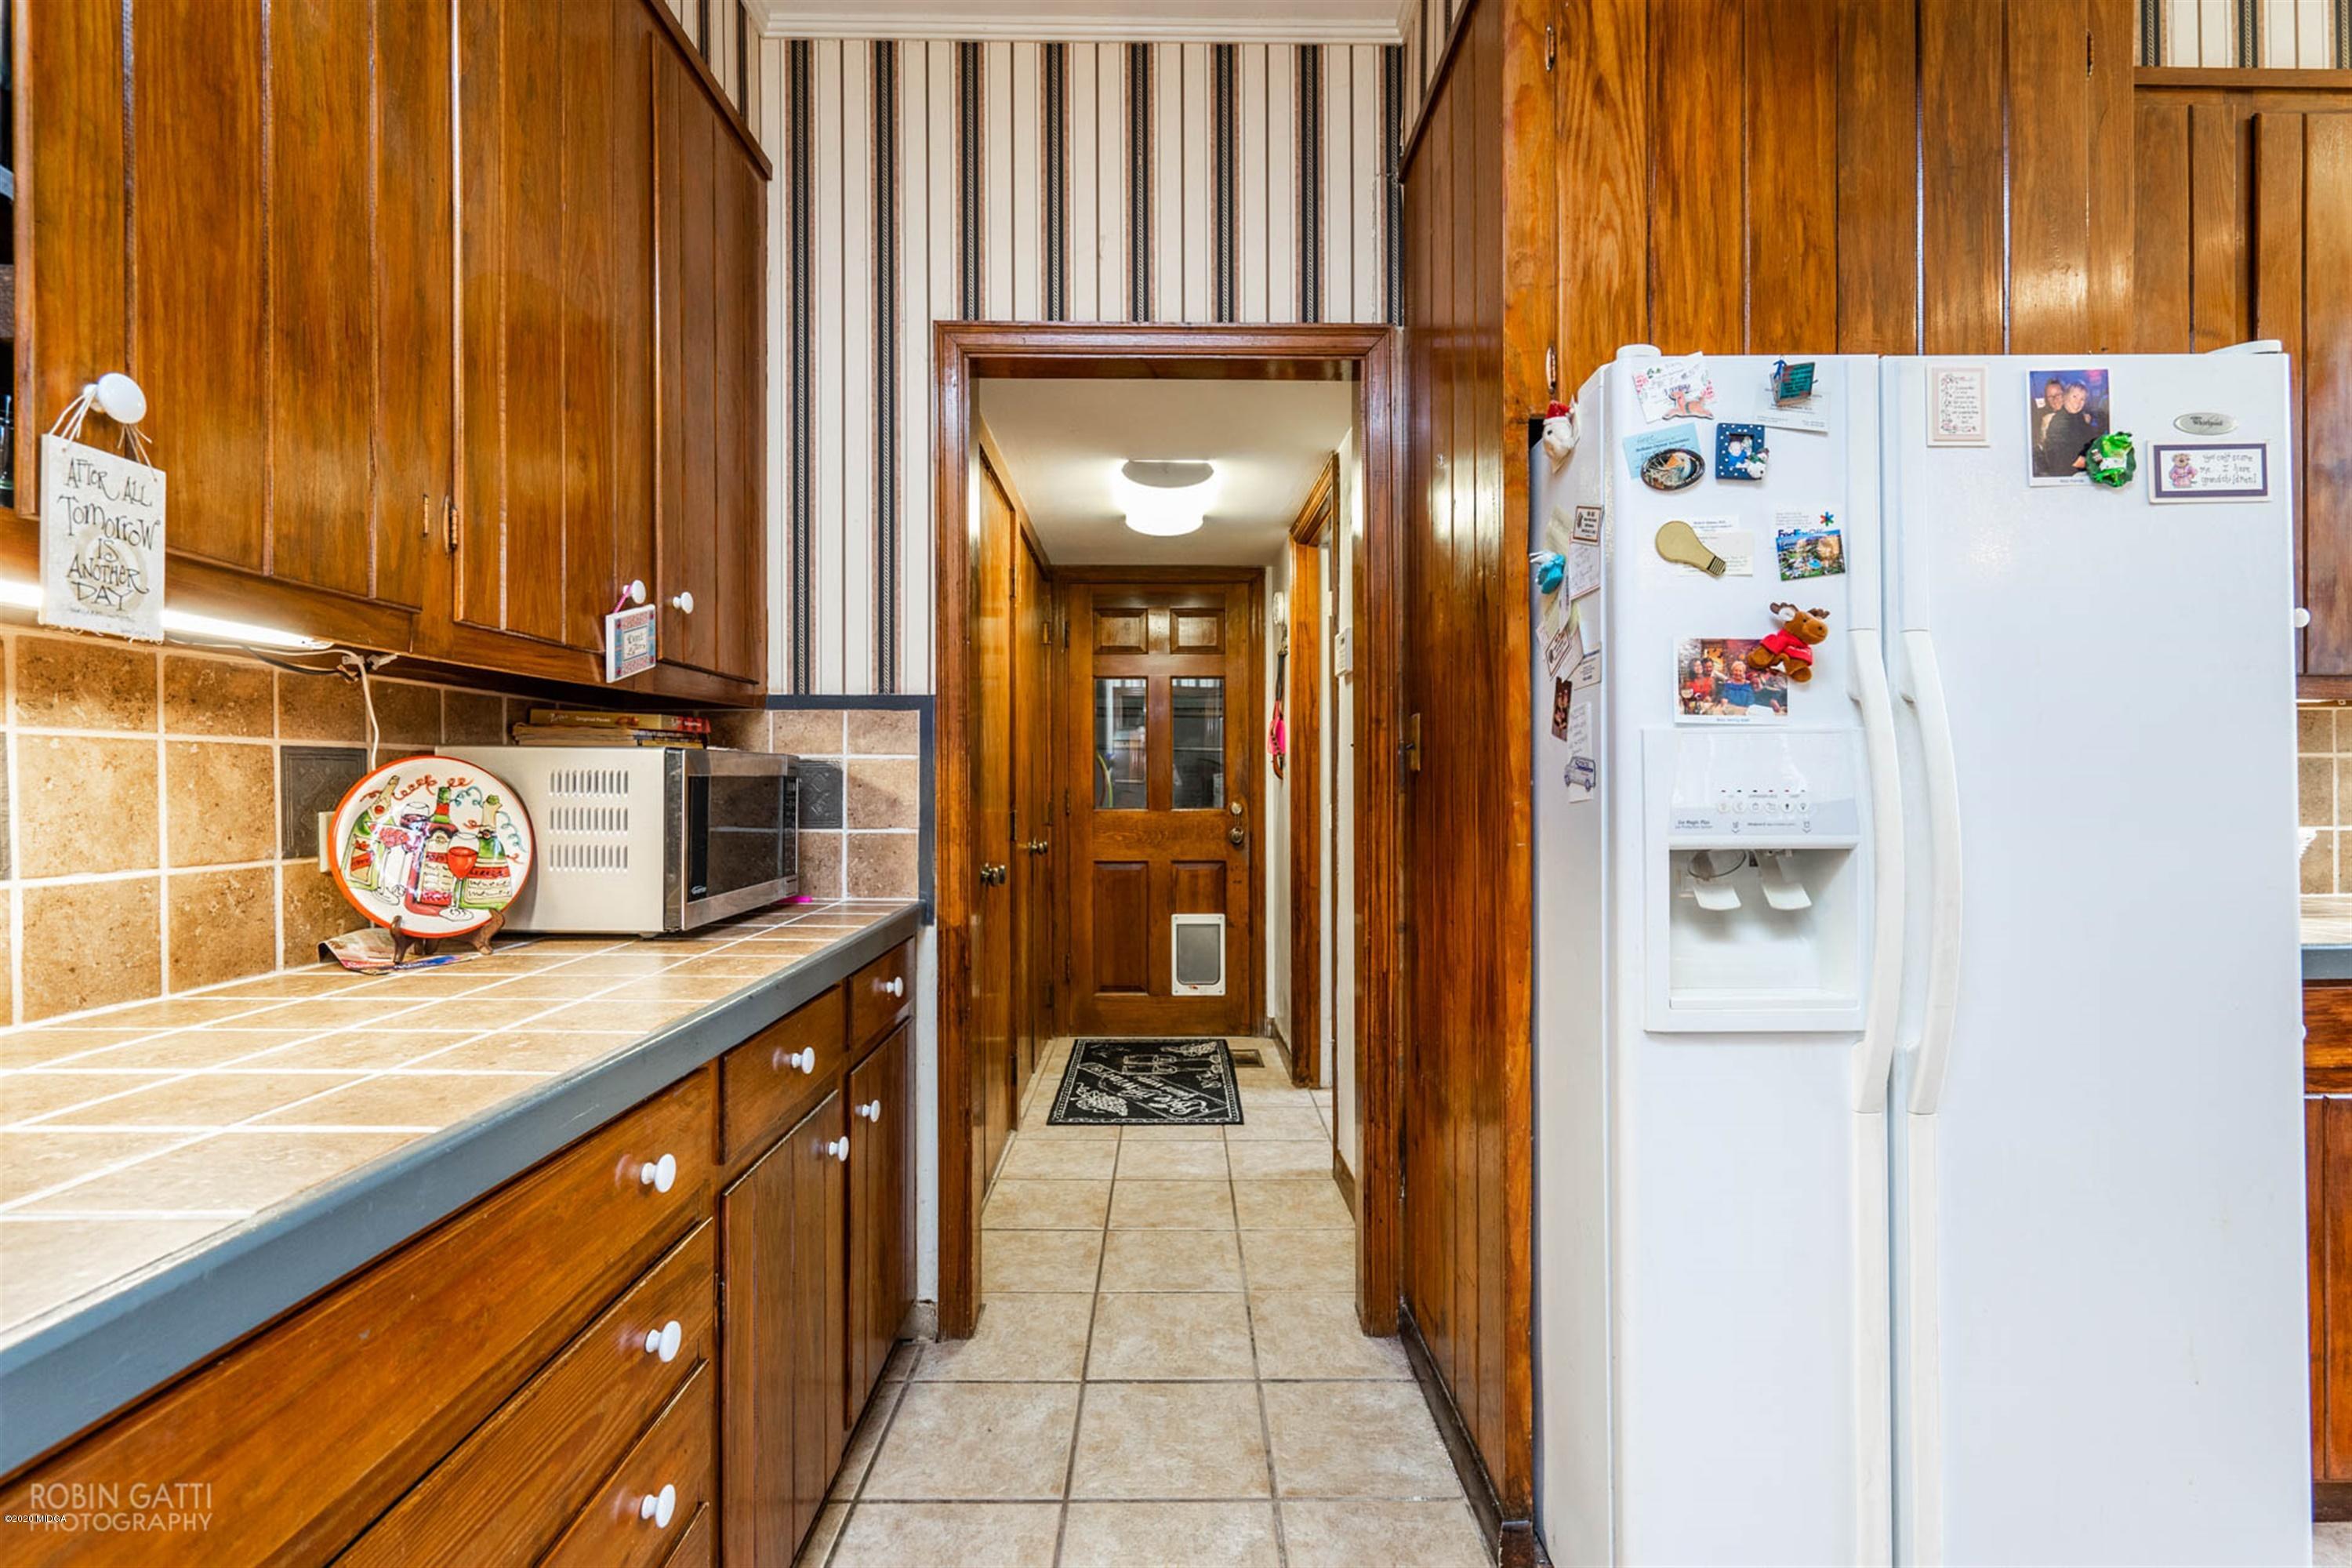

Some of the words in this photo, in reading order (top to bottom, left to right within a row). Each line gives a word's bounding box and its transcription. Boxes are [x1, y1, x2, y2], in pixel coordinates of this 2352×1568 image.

[2192, 419, 2223, 427] Whirlpool
[122, 477, 152, 506] ALL
[97, 538, 118, 563] IS
[71, 581, 133, 612] DAY
